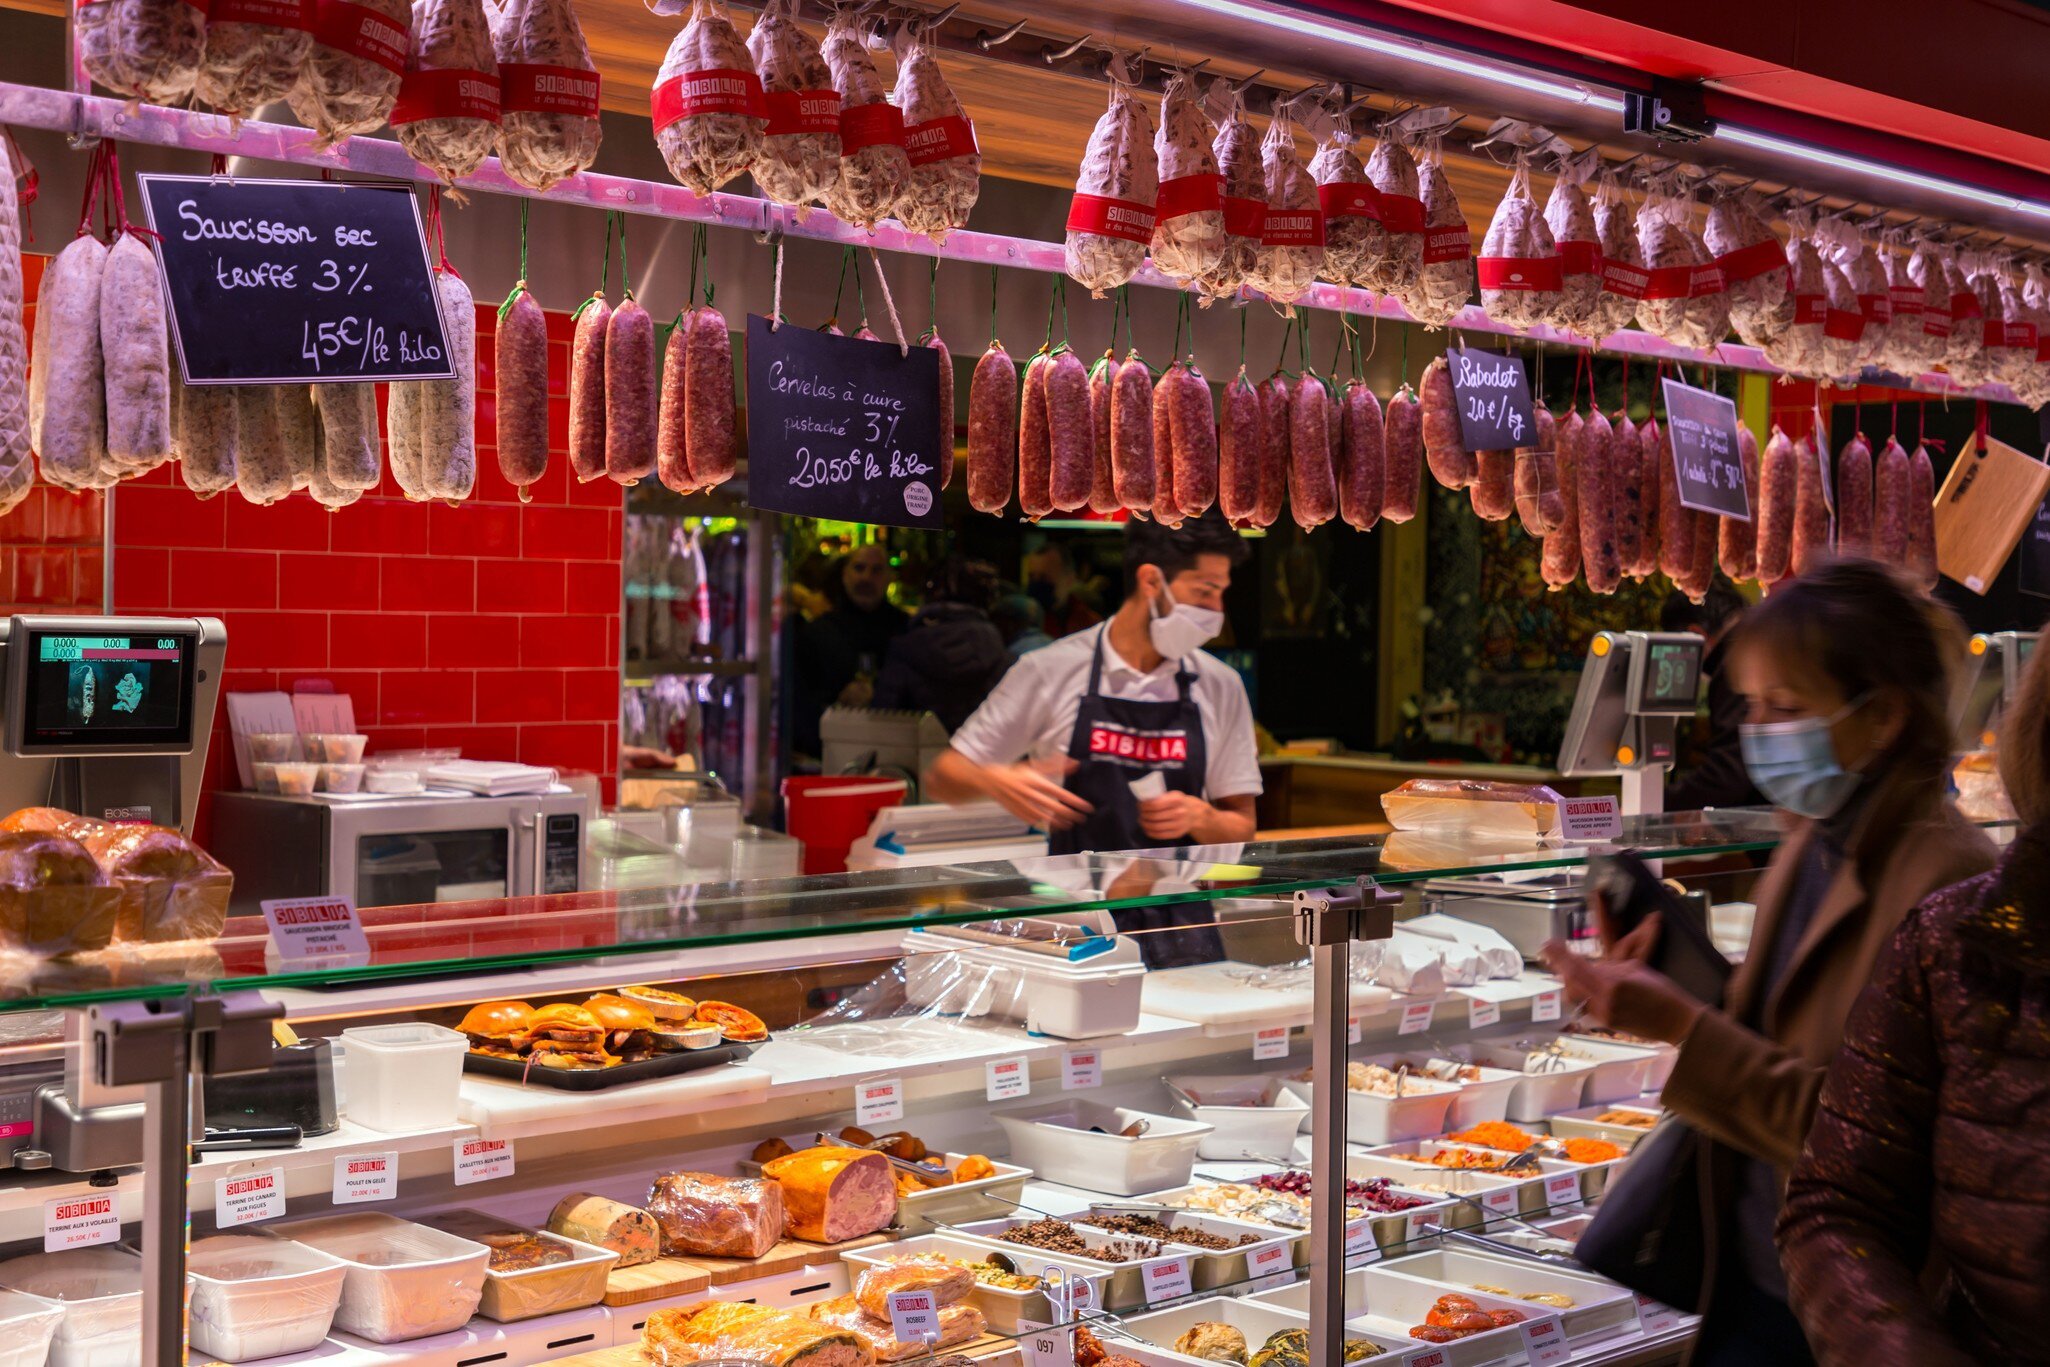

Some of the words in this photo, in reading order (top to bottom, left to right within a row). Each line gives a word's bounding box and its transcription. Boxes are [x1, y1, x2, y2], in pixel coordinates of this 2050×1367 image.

[535, 75, 597, 99] SIBILIA
[681, 78, 746, 98] SIBILIA
[178, 200, 317, 245] Saucisson
[335, 226, 377, 247] sec
[217, 257, 298, 290] truffé
[399, 331, 441, 363] kilo
[1455, 356, 1519, 389] Sabodet
[768, 360, 835, 400] Cervelas
[843, 381, 857, 401] à
[863, 390, 906, 411] cuire
[784, 416, 850, 441] pistaché
[864, 452, 882, 481] le
[890, 450, 934, 478] kilo
[906, 494, 929, 502] ORIGINE
[907, 502, 928, 510] FRANCE
[1090, 729, 1187, 760] SIBILIA
[1566, 802, 1613, 815] SIBILIA
[273, 903, 352, 926] SIBILIA
[284, 926, 322, 935] SAUCISSON
[463, 1140, 505, 1156] SIBILIA
[348, 1160, 386, 1174] SIBILIA
[459, 1160, 484, 1169] CAILLETTES
[226, 1175, 273, 1196] SIBILIA
[226, 1198, 247, 1207] TERRINE
[255, 1192, 277, 1201] CANARD
[248, 1202, 267, 1210] FIGUES
[56, 1199, 111, 1220] SIBILIA
[49, 1224, 72, 1233] TERRINE
[90, 1217, 118, 1226] VOLAILLES
[895, 1297, 930, 1311] SIBILIA
[905, 1315, 926, 1324] ROSBEEF
[1036, 1338, 1054, 1354] 097
